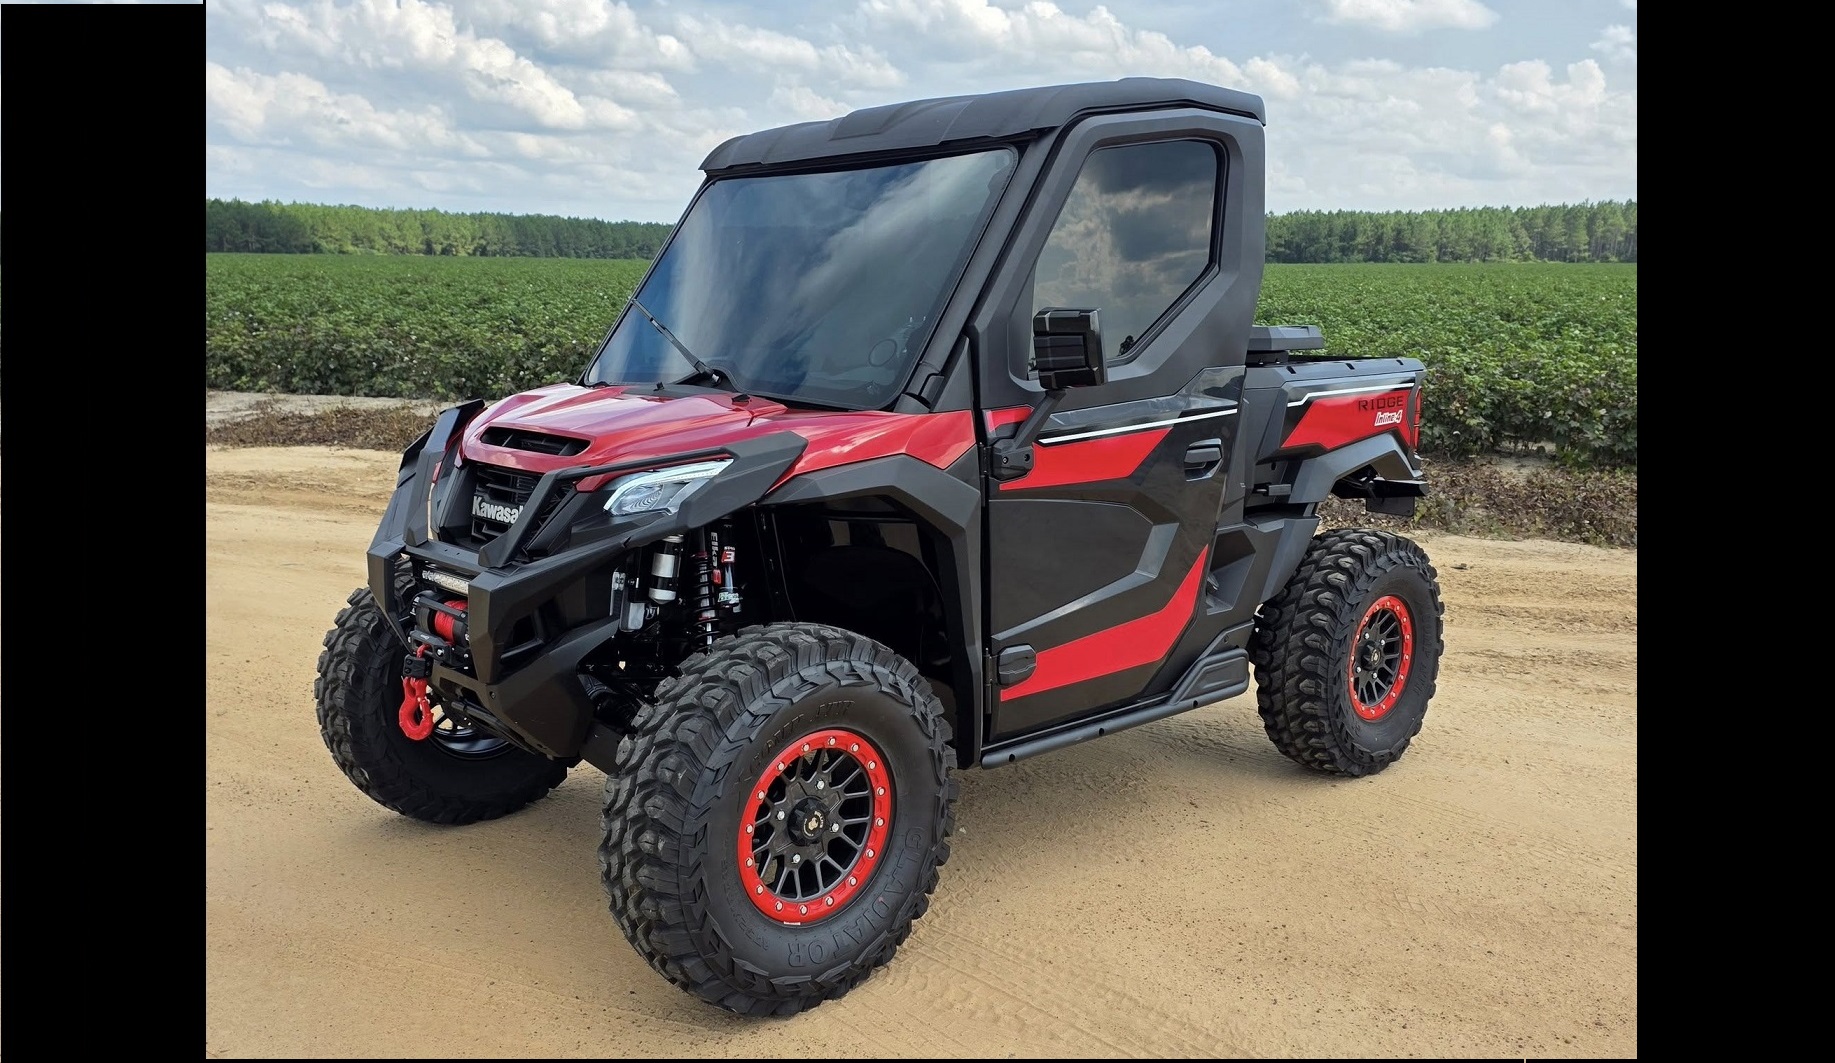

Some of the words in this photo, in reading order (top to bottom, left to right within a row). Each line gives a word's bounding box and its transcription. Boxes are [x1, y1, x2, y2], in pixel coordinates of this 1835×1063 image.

[1358, 396, 1404, 411] RIDGE
[471, 495, 524, 524] Kawasa
[786, 826, 925, 968] GLADIATOR
